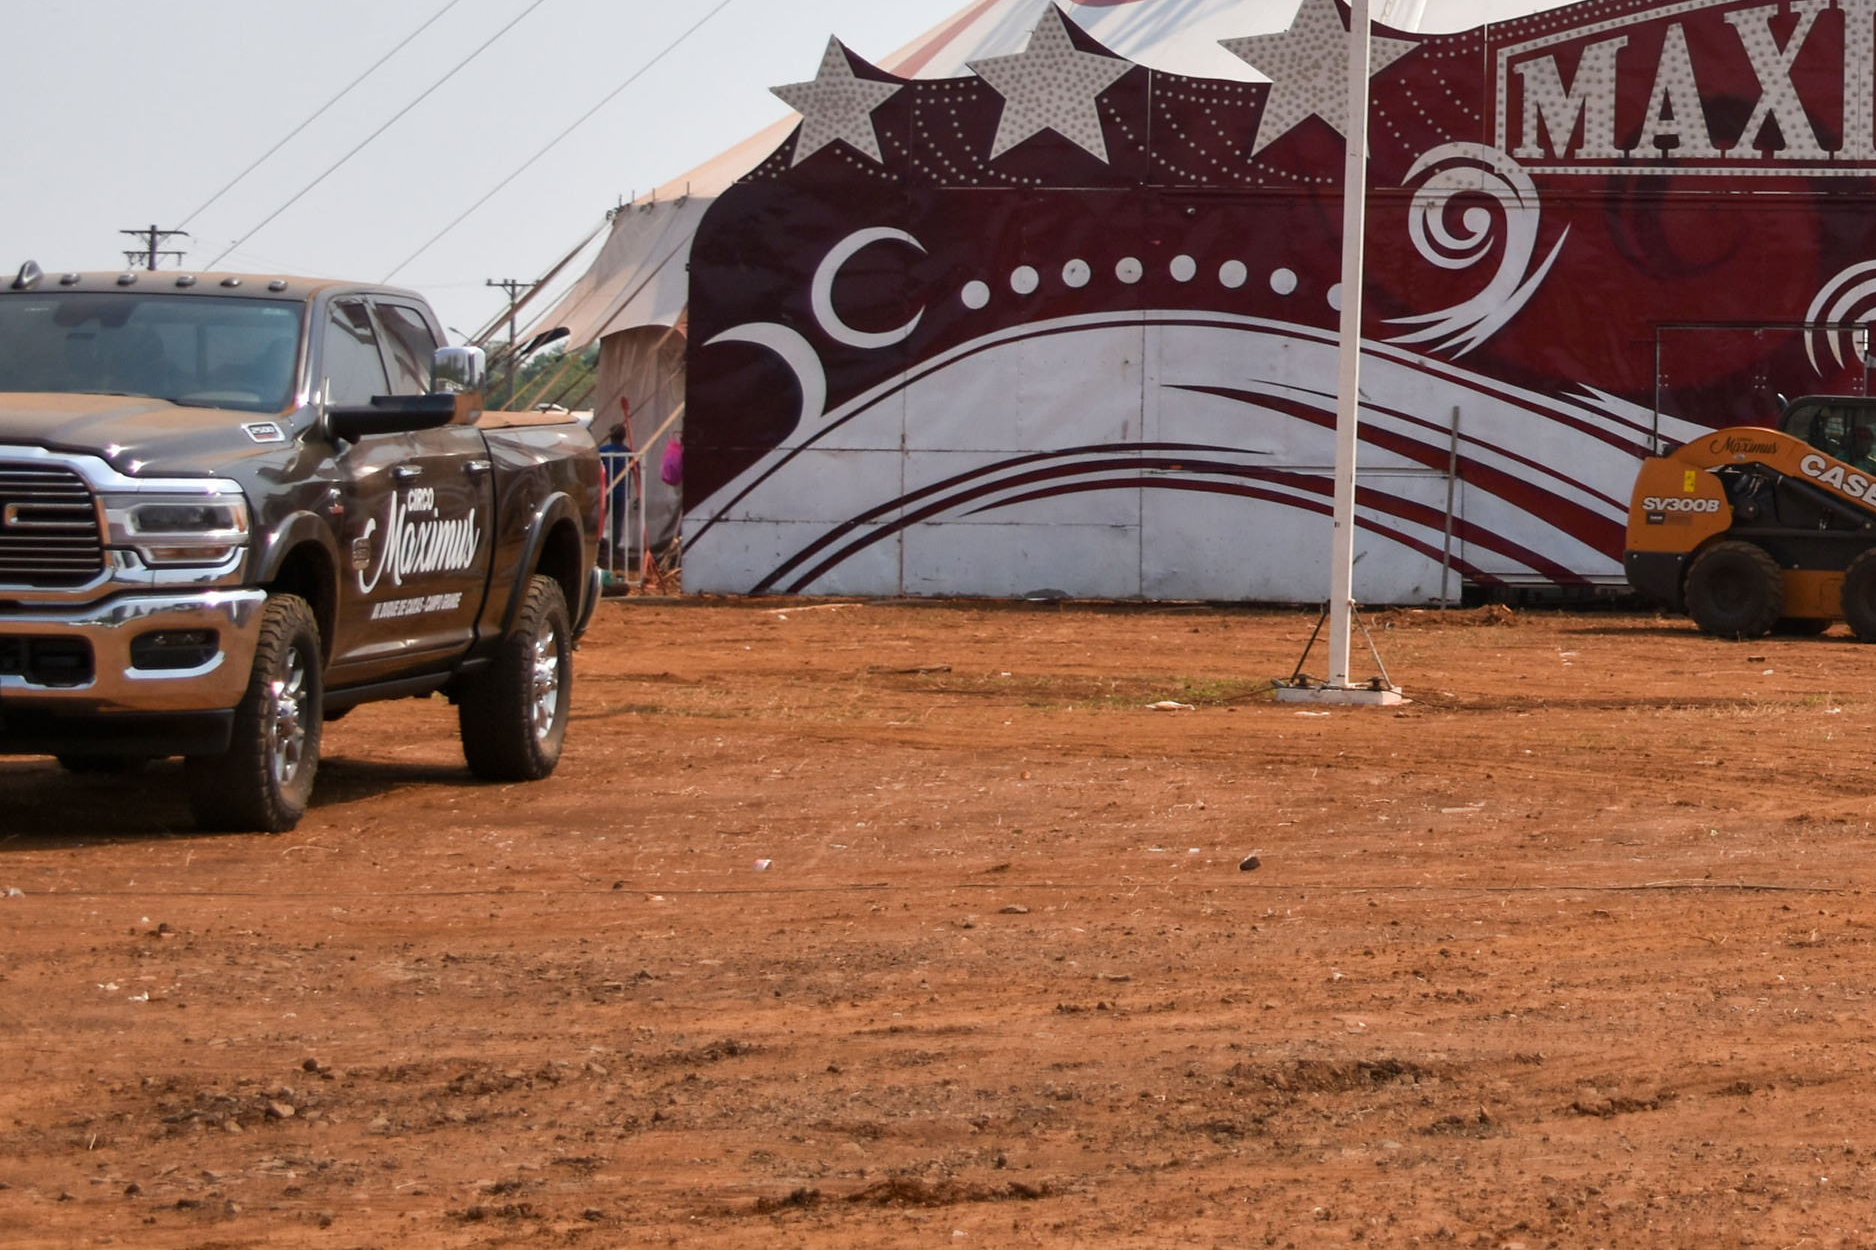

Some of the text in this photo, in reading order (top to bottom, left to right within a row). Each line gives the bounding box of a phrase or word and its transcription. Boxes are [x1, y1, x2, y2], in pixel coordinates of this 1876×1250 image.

[1709, 434, 1779, 455] Maximus
[408, 487, 434, 512] CIRCO
[1642, 496, 1721, 513] SV300B
[358, 490, 481, 594] Maximus
